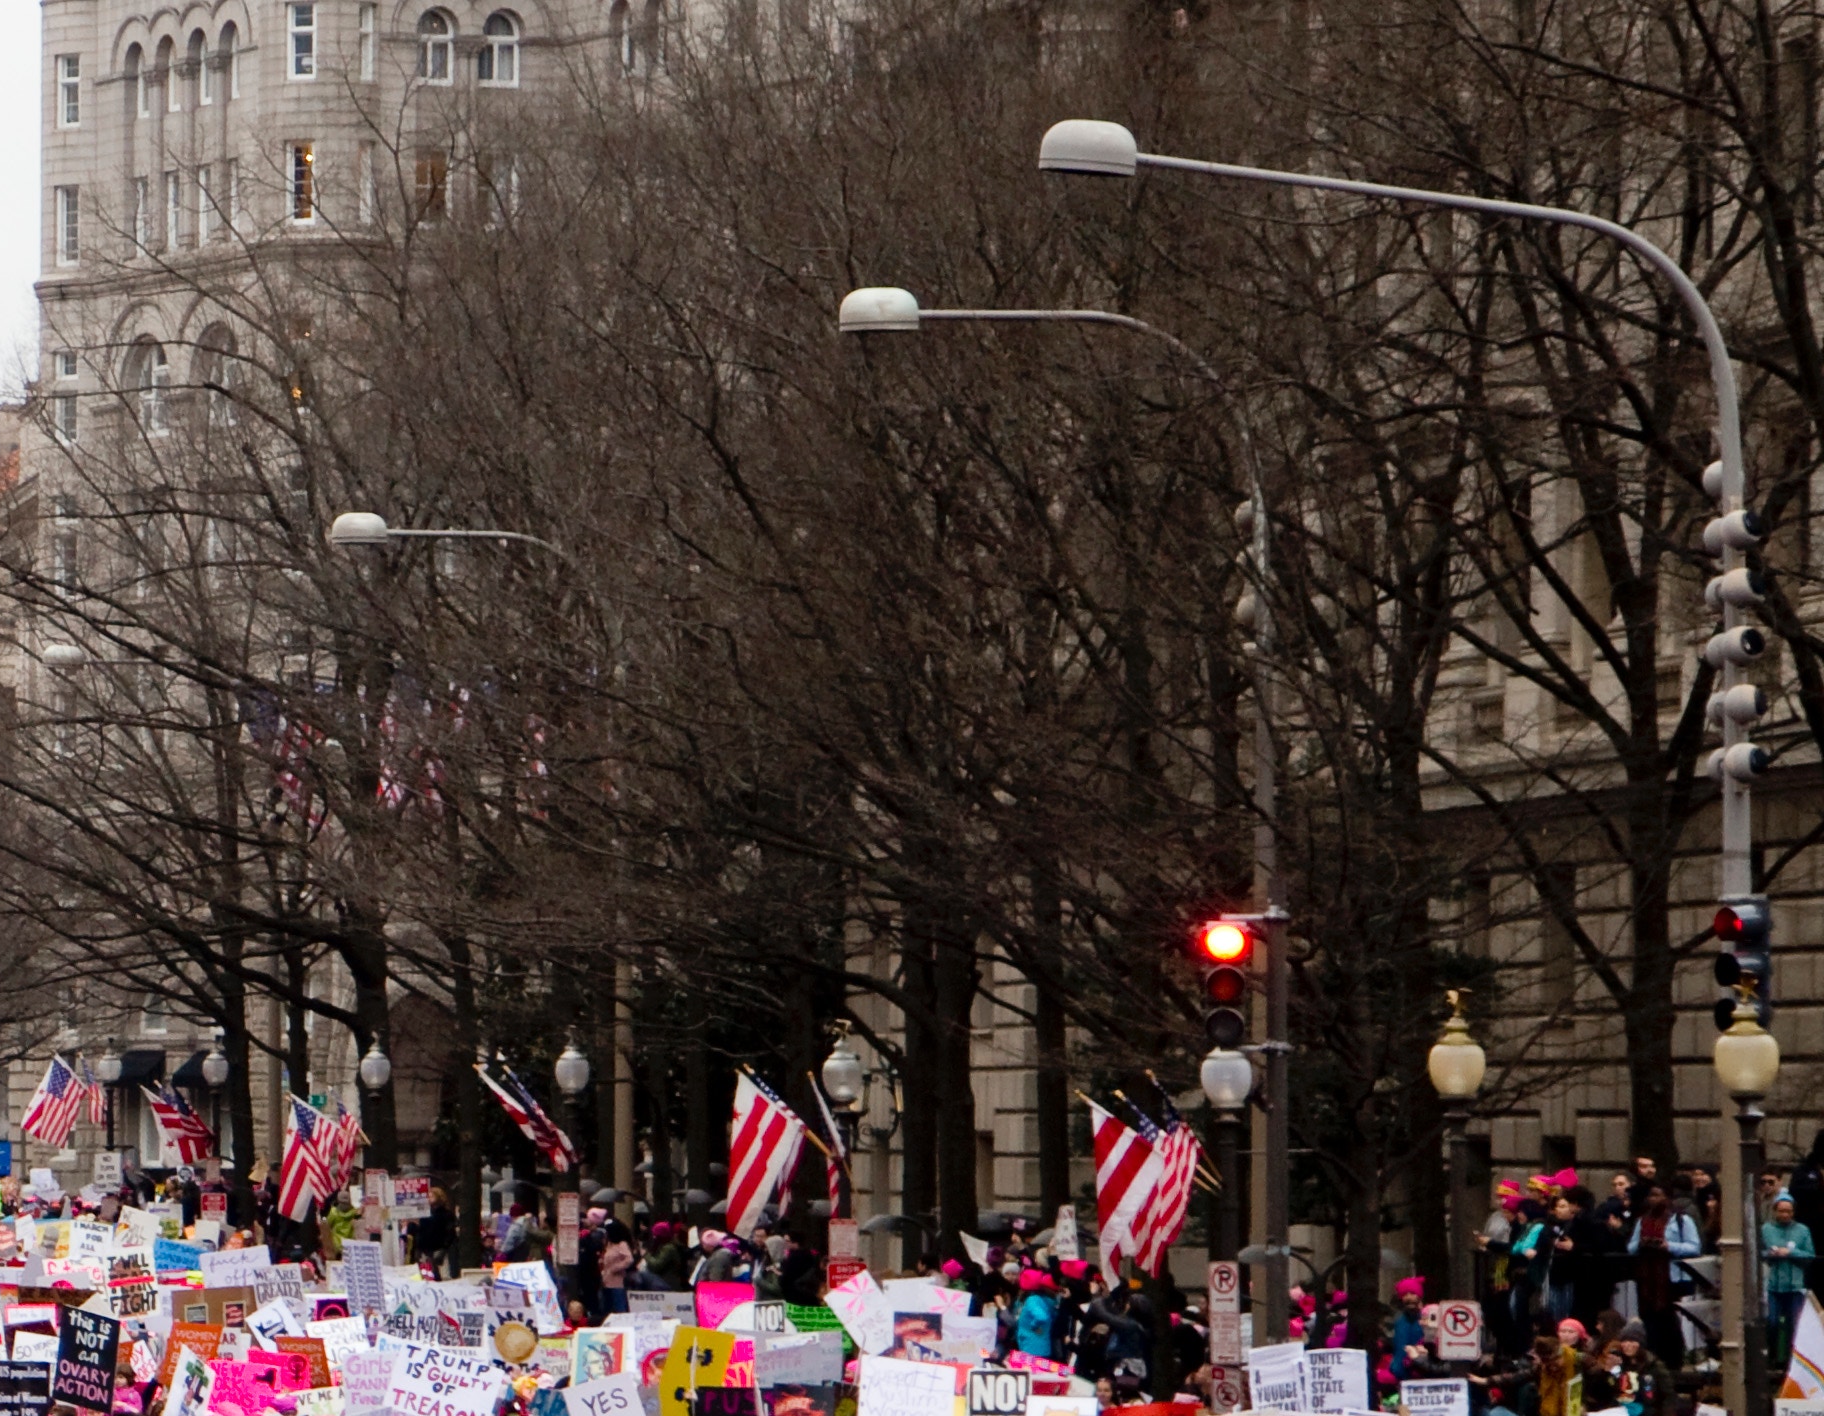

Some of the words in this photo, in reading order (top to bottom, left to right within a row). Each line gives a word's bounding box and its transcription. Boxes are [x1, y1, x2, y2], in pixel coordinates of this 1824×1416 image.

[73, 1331, 106, 1350] NOT
[61, 1363, 110, 1386] OVARY
[56, 1377, 109, 1403] ACTION
[972, 1376, 1026, 1405] NO!
